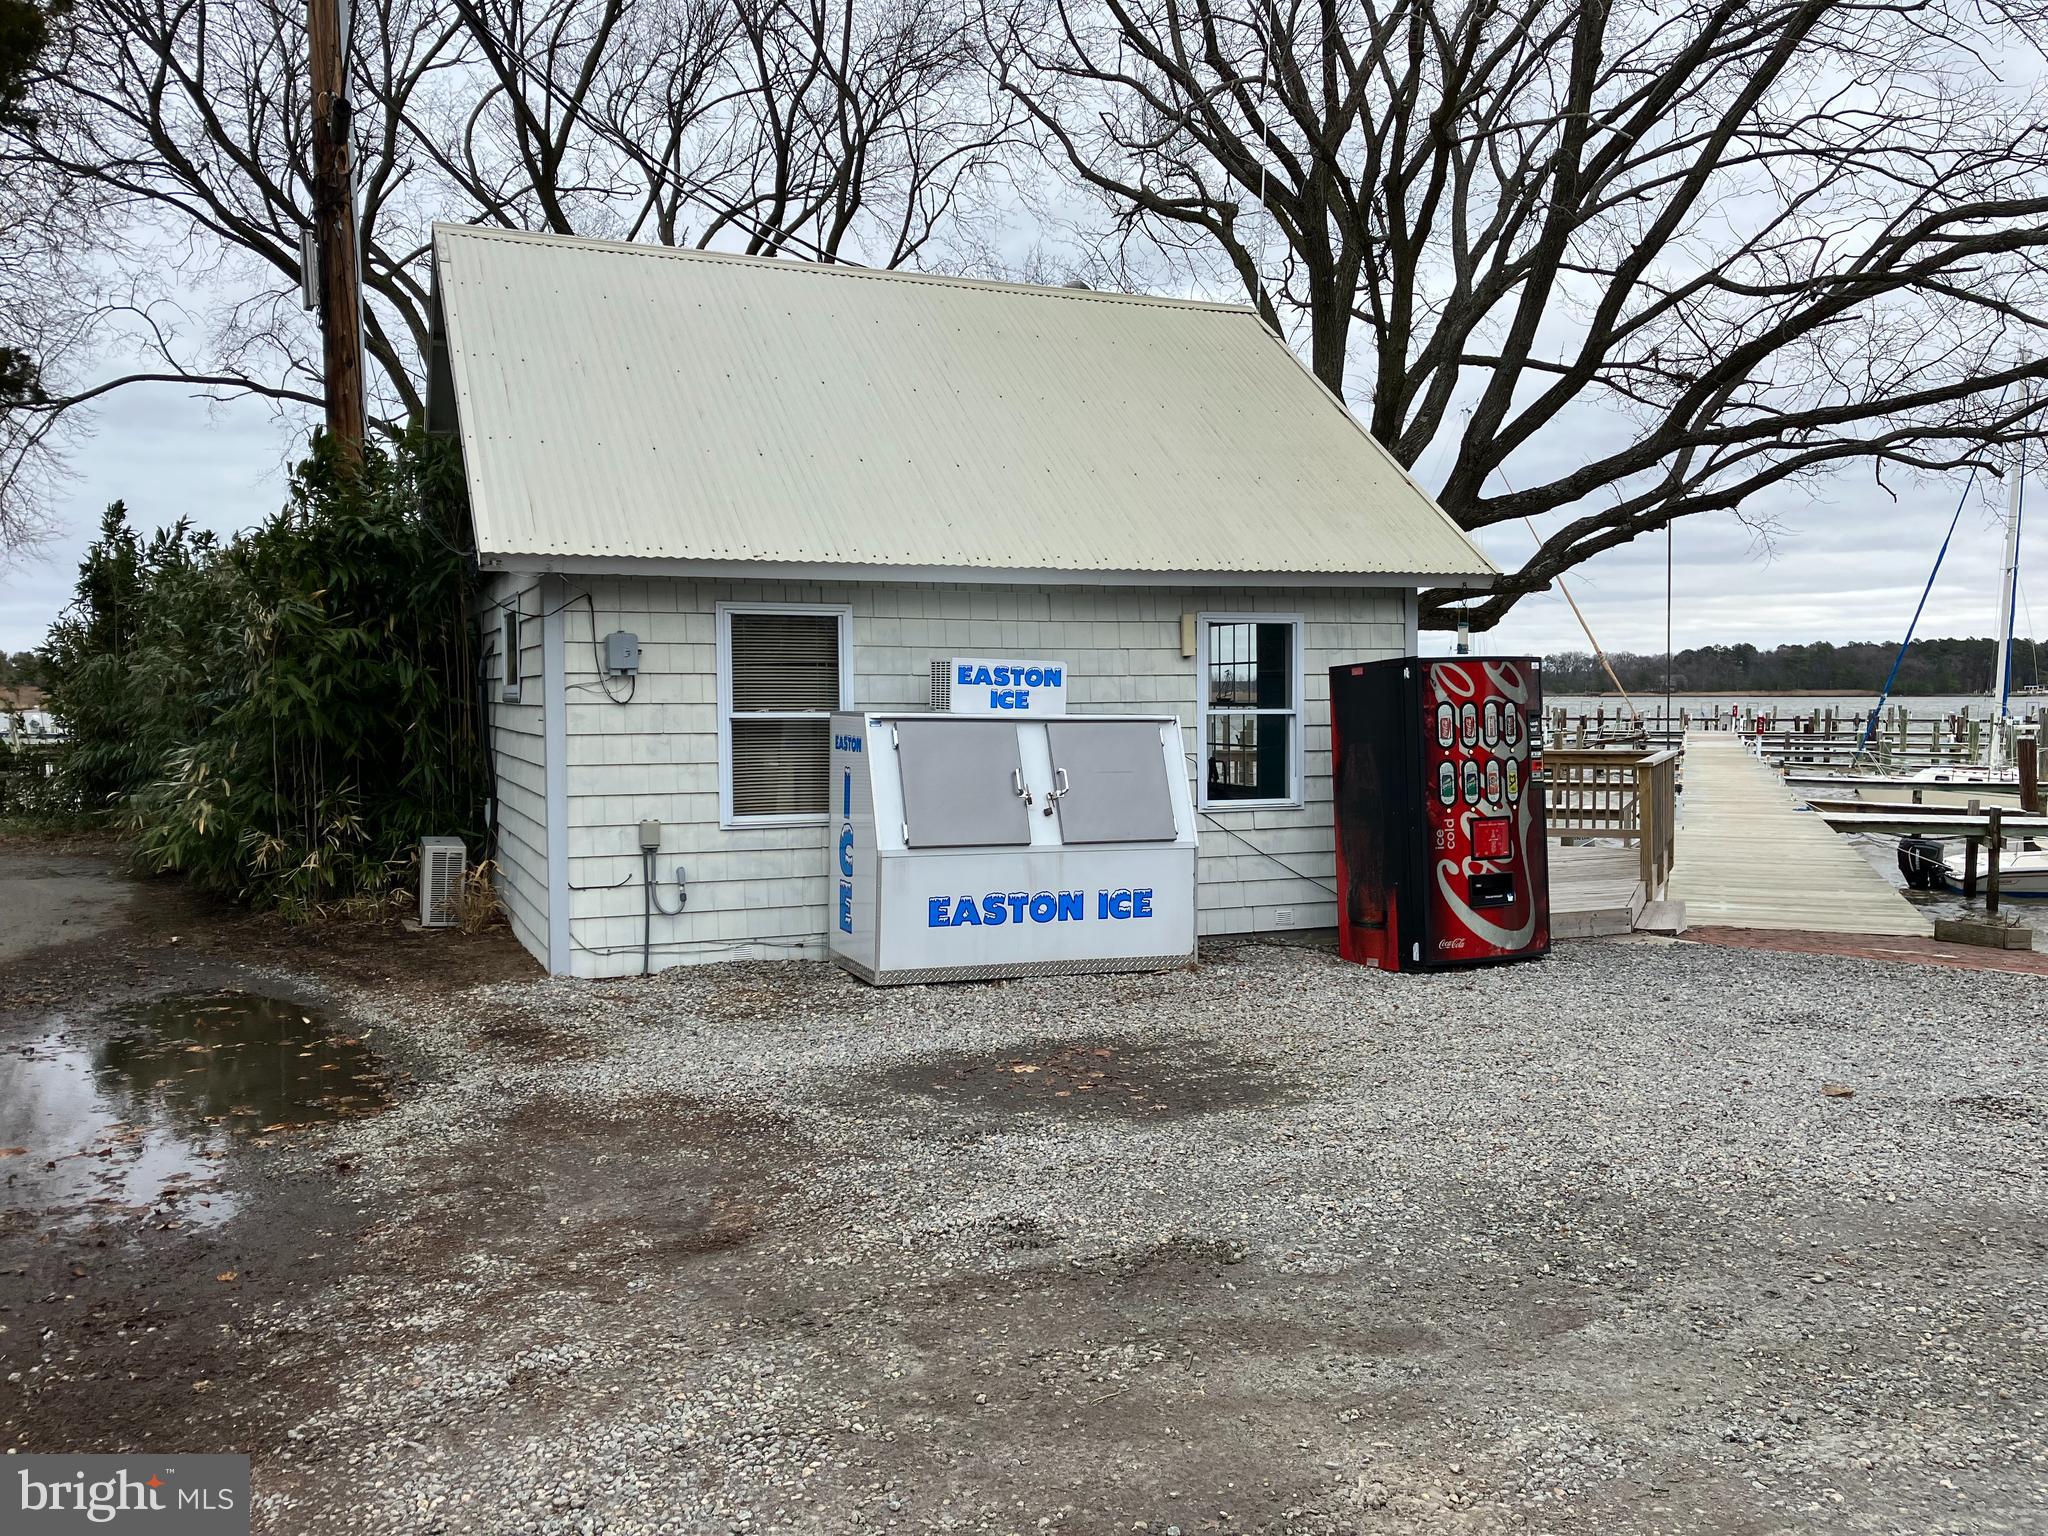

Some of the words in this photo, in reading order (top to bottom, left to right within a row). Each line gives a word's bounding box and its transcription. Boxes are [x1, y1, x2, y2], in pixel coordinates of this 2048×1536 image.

[957, 664, 1062, 688] EASTON
[990, 688, 1030, 710] ICE
[834, 733, 862, 752] EASTON
[1434, 829, 1445, 850] ice
[1444, 818, 1456, 850] cold
[839, 765, 854, 935] ICE
[928, 889, 1085, 928] EASTON
[1097, 887, 1154, 920] ICE
